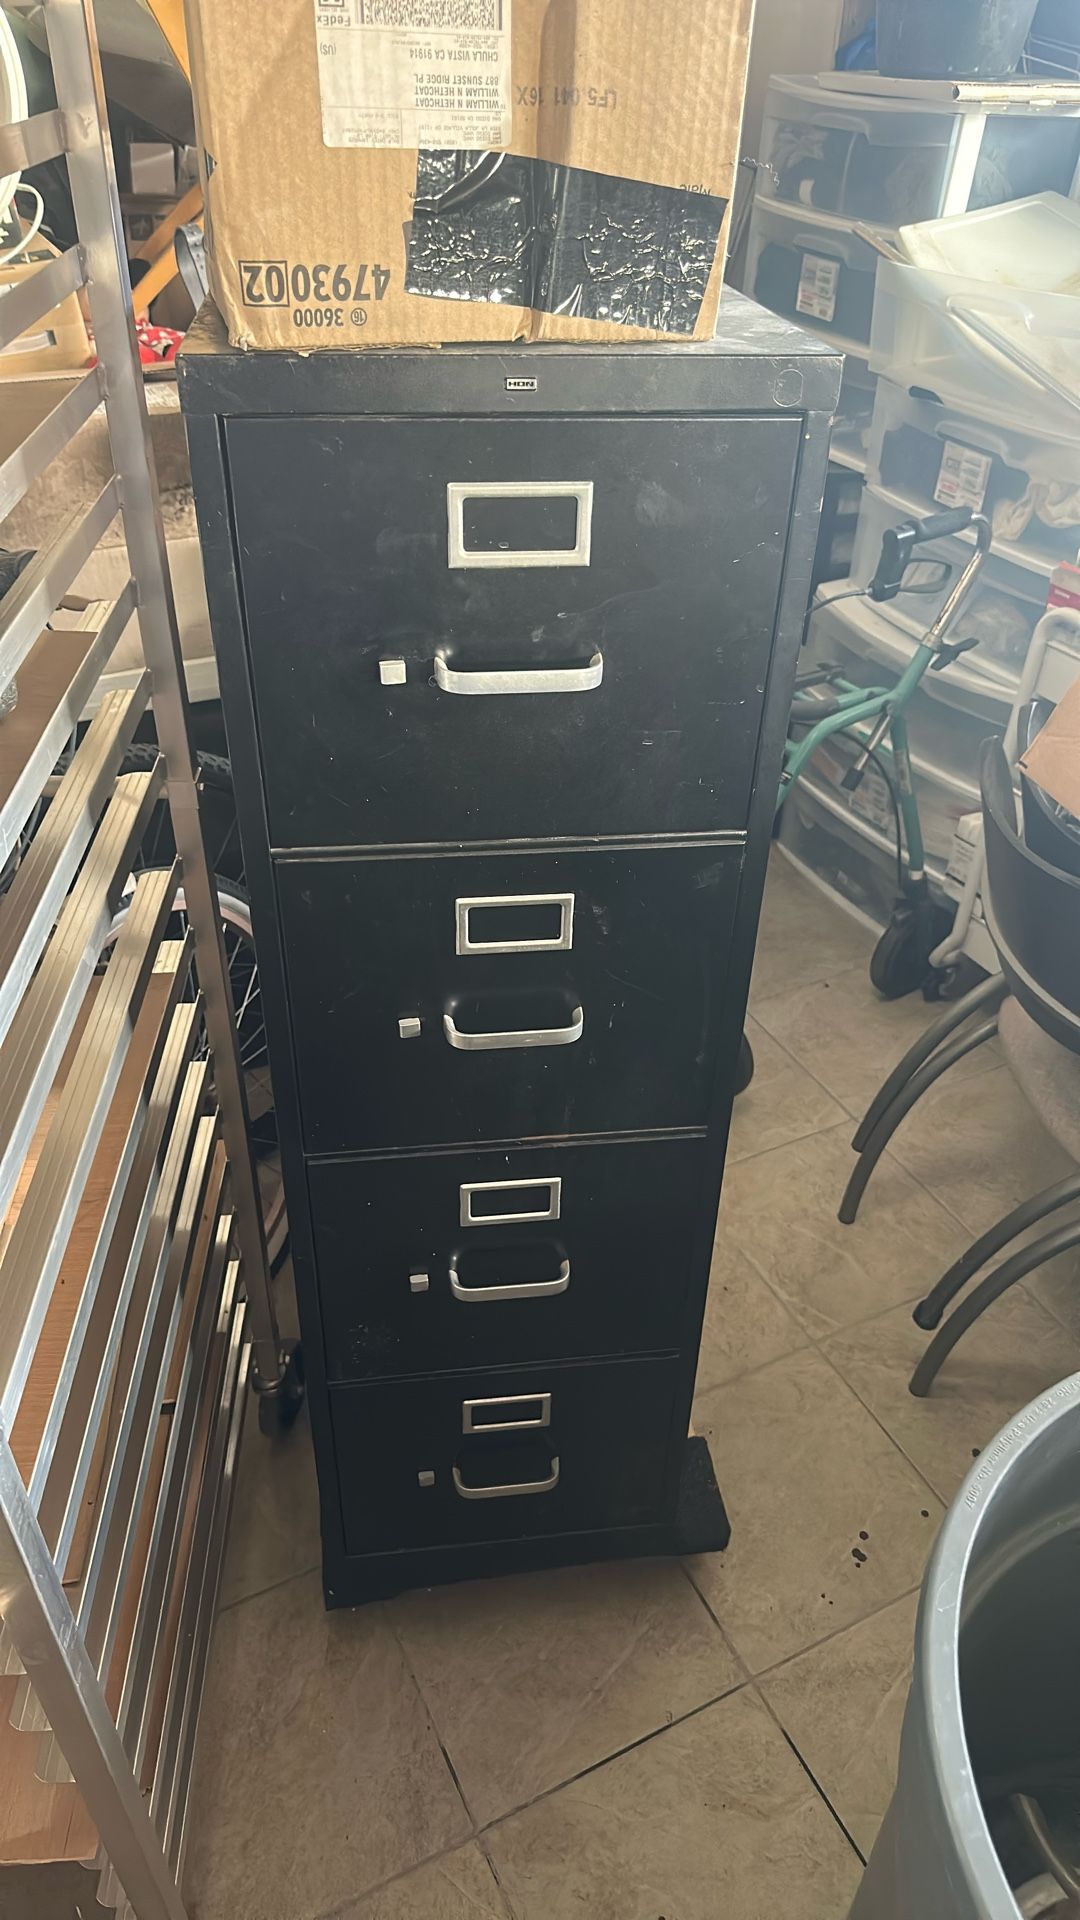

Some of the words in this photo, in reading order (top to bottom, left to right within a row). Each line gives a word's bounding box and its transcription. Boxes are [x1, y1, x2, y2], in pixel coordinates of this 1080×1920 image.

[317, 15, 351, 27] FedEx
[320, 41, 336, 56] (US)
[409, 48, 433, 60] 91914
[434, 49, 445, 60] CA
[447, 49, 471, 61] VISTA
[472, 50, 499, 62] CHULA
[414, 73, 424, 84] PL
[426, 74, 450, 85] RIDGE
[453, 75, 483, 86] SUNSET
[415, 85, 455, 97] HETHCOAT
[457, 87, 463, 97] N
[465, 87, 499, 98] WILLIAM
[517, 86, 544, 106] 16X
[415, 97, 455, 108] HETHCOAT
[457, 99, 463, 108] N
[465, 99, 499, 109] WILLIAM
[293, 308, 344, 327] 36000
